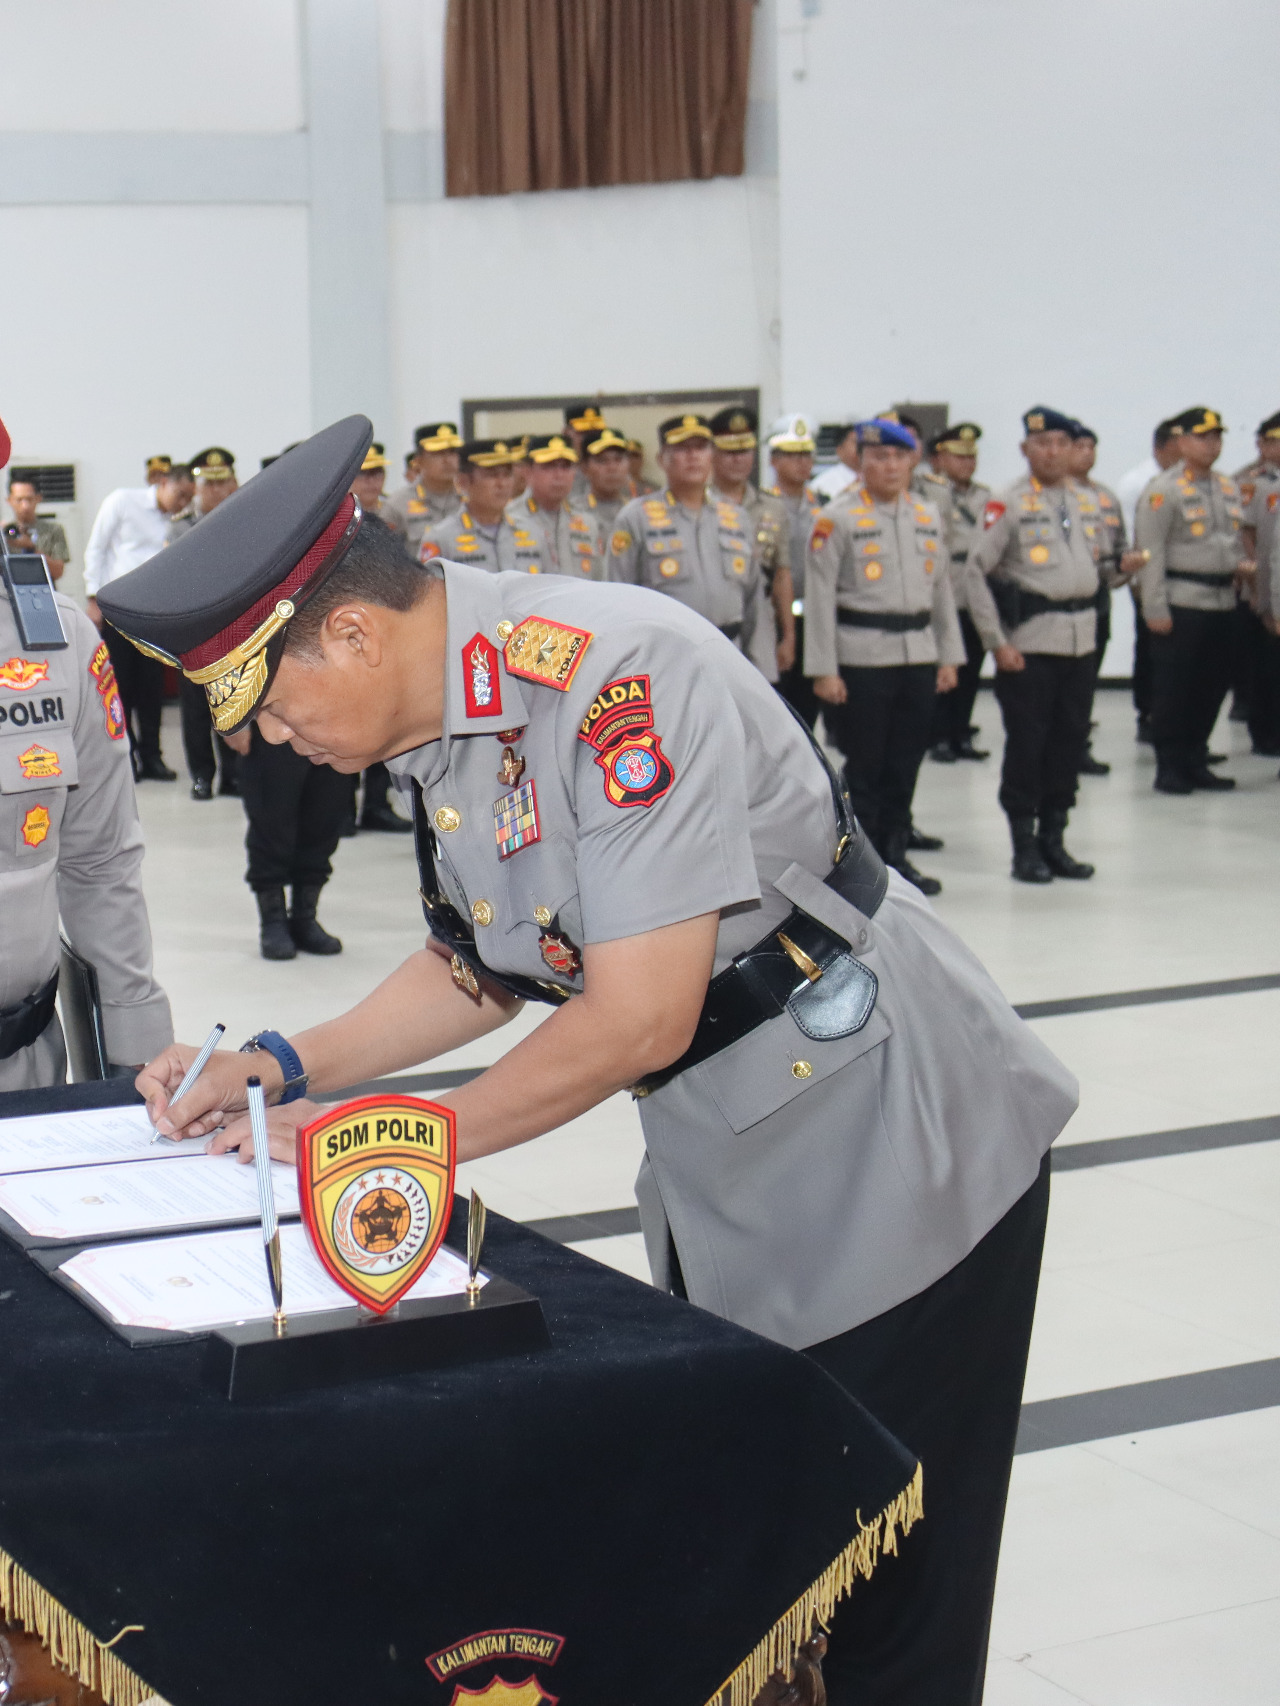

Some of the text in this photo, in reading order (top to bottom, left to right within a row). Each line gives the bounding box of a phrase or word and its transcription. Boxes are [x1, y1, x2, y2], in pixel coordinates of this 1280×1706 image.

[556, 637, 583, 681] POLISI
[581, 681, 645, 734] POLDA
[625, 714, 648, 723] TENGAH
[326, 1118, 434, 1159] SDM POLRI
[436, 1634, 555, 1675] KALIMANTAN TENGAH
